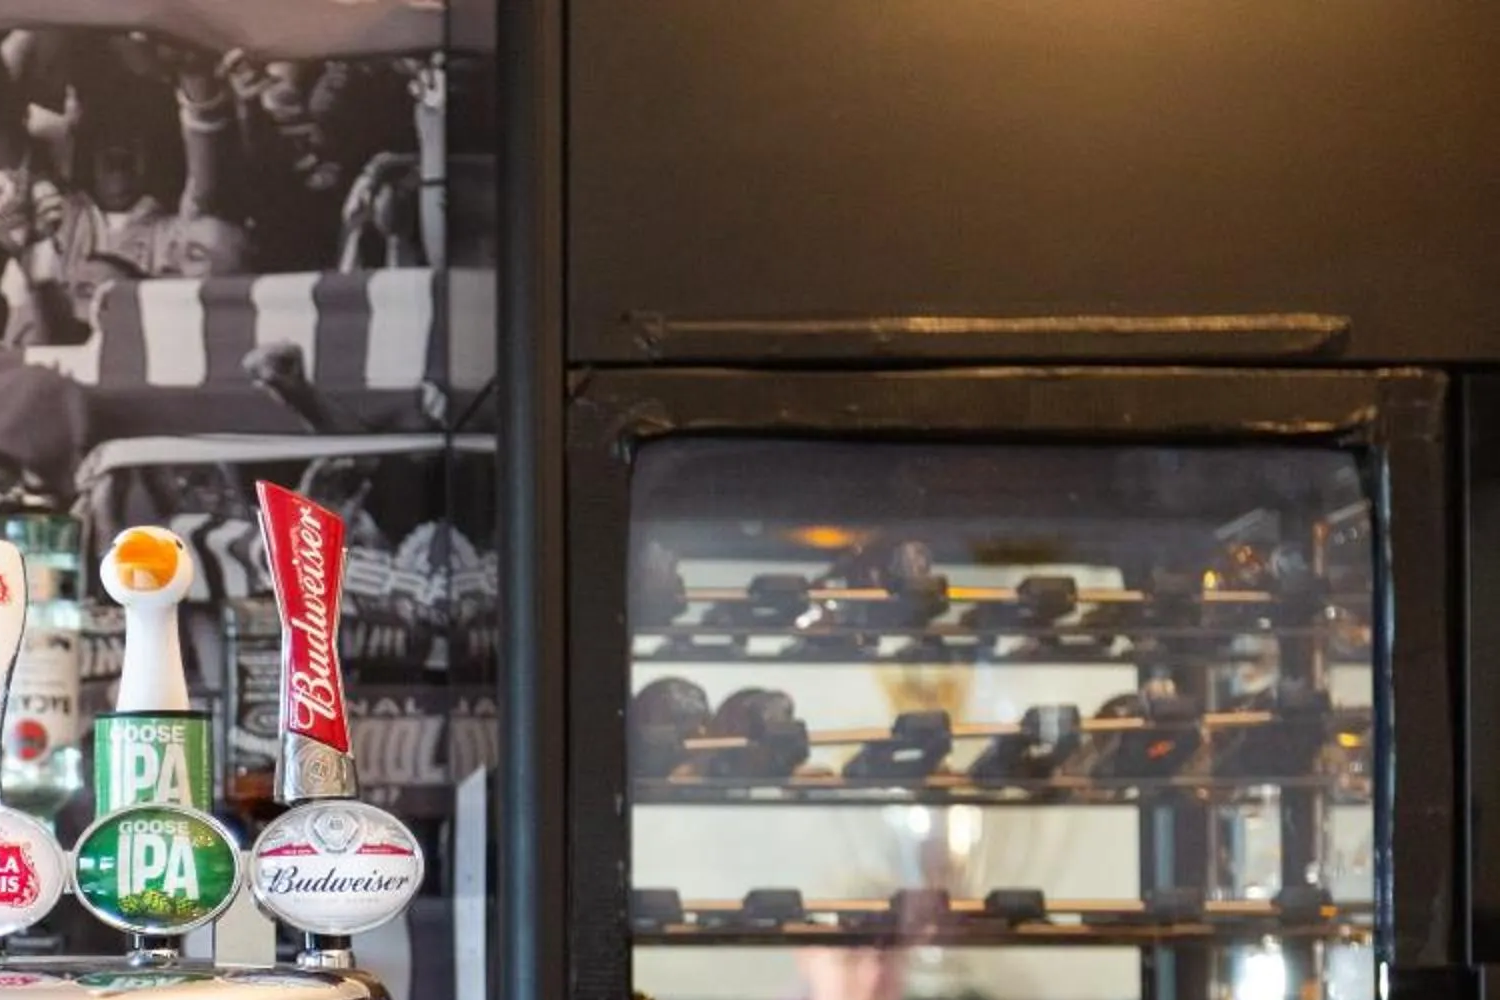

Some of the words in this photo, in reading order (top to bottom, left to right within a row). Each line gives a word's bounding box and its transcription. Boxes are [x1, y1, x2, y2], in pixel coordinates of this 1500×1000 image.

[291, 505, 337, 730] Budweiser
[111, 723, 187, 744] GOOSE
[110, 741, 194, 811] IPA
[119, 819, 190, 835] GOOSE
[117, 833, 200, 901] IPA
[261, 864, 410, 895] Budweiser
